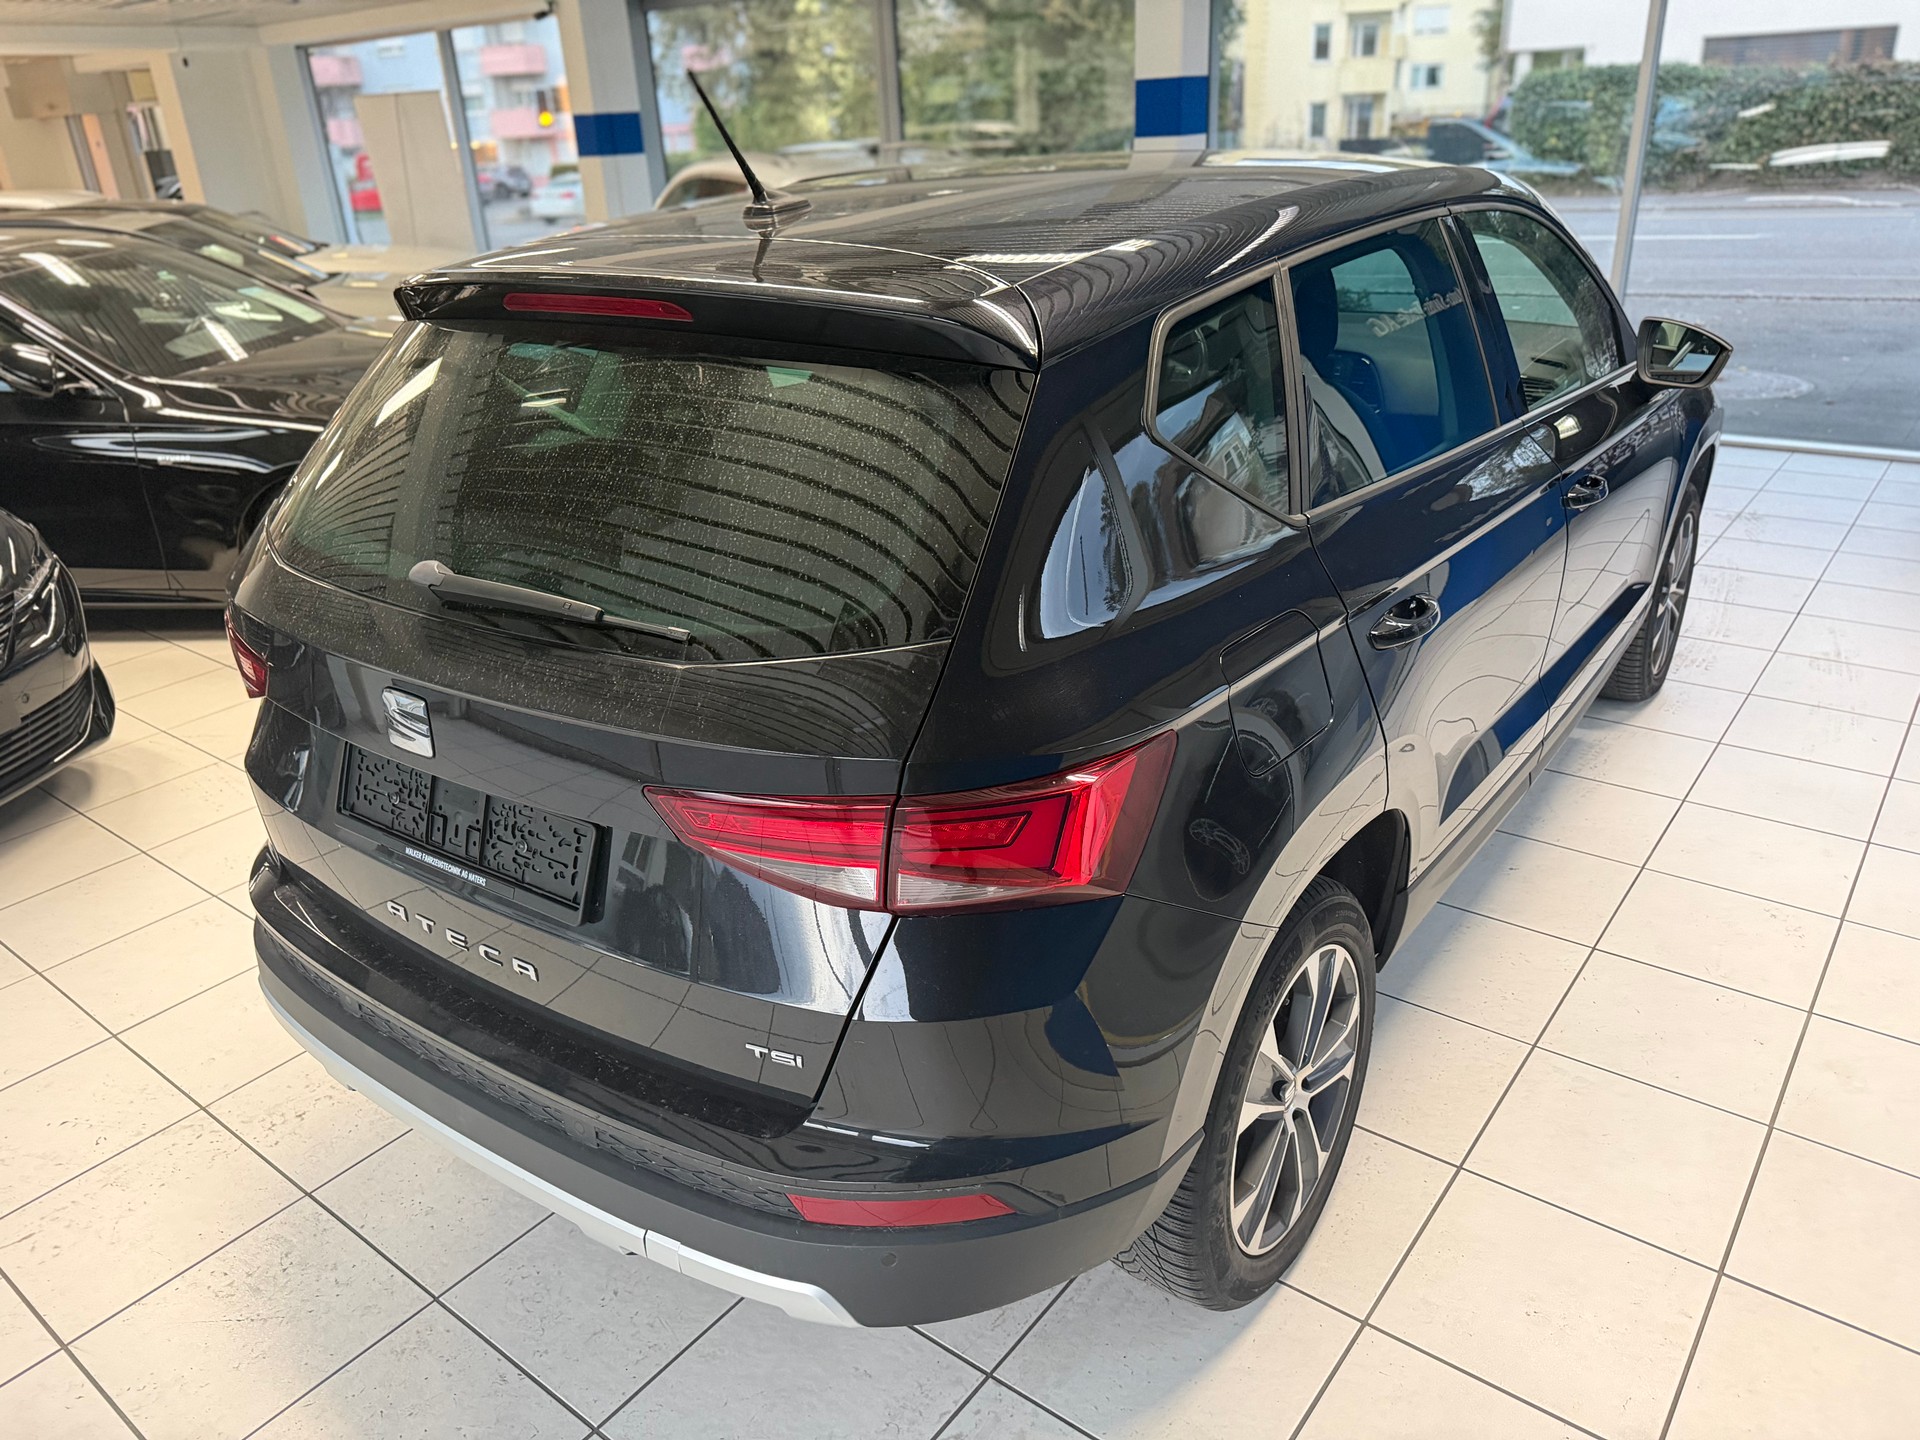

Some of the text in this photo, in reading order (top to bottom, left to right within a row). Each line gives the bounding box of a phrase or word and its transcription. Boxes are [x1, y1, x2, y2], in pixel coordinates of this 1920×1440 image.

[421, 854, 462, 876] FAHRZEUGTECHNIK
[461, 869, 469, 879] AG
[468, 873, 487, 887] NATERS
[386, 899, 539, 983] ATECA
[745, 1042, 804, 1069] TSI
